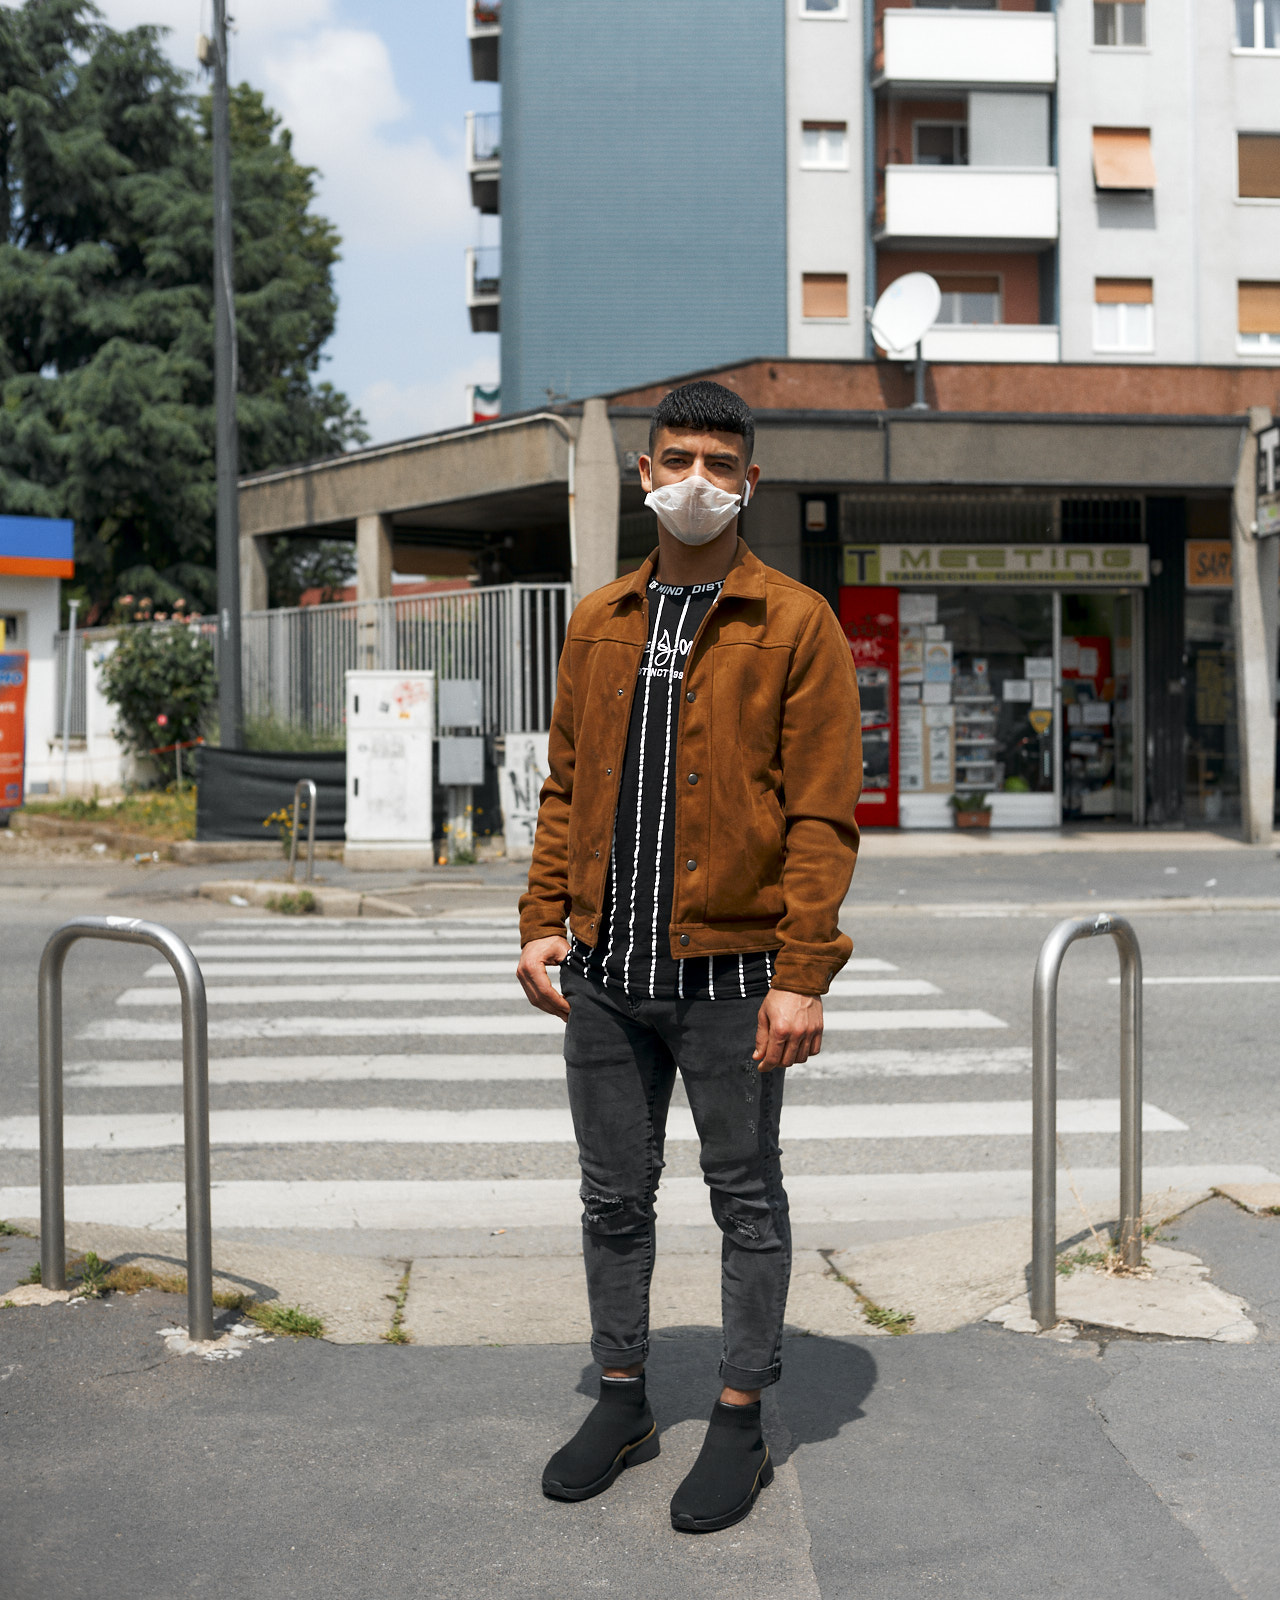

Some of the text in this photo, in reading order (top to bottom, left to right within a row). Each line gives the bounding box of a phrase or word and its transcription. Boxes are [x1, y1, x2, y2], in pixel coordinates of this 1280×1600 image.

[847, 550, 876, 582] T
[901, 549, 1131, 569] MEETING
[656, 584, 684, 596] MIND
[691, 580, 726, 594] DIST
